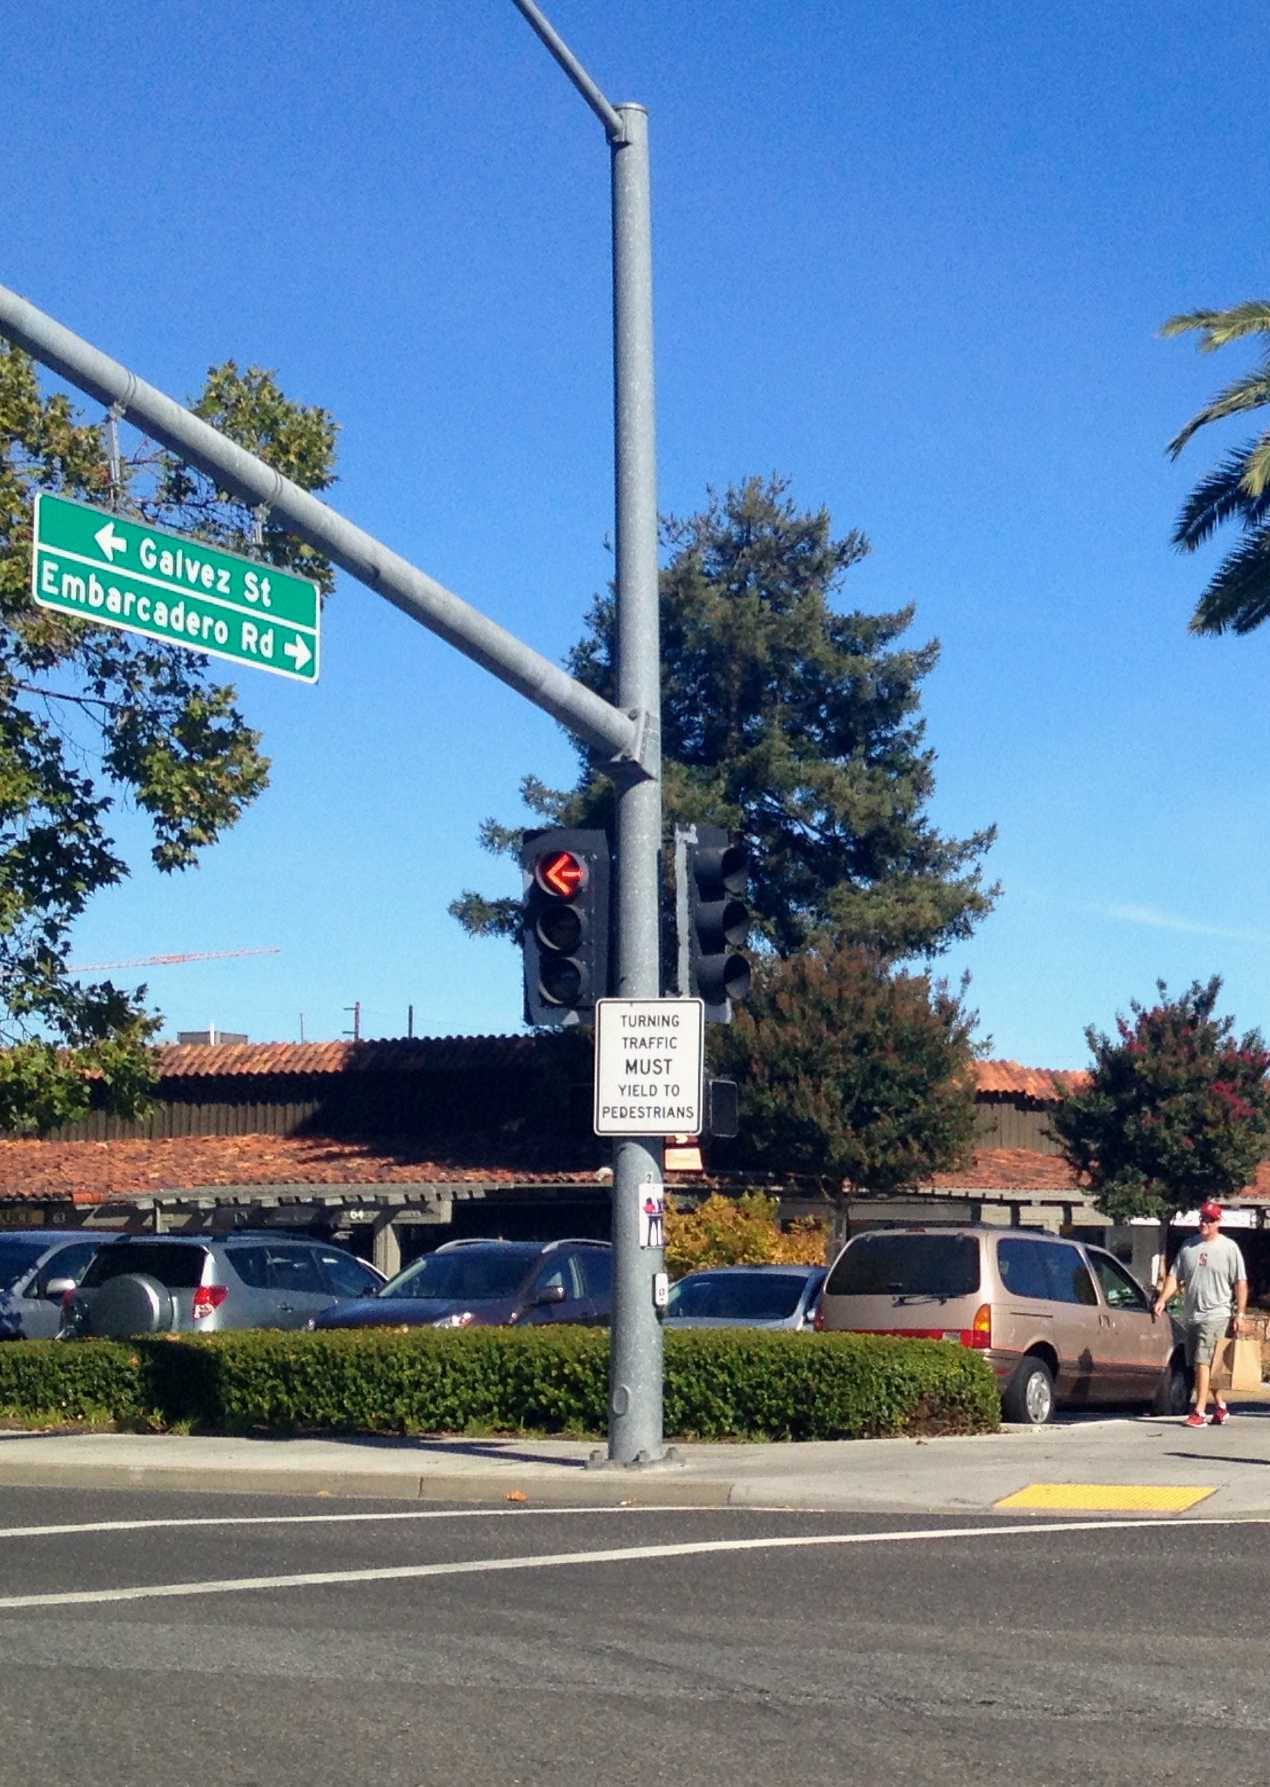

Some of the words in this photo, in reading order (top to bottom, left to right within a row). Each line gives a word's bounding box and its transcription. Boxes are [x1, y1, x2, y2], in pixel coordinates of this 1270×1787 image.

[139, 538, 231, 594] Galvez
[243, 571, 272, 607] St
[41, 560, 229, 644] Embarcadero
[241, 621, 274, 658] Rd
[620, 1014, 680, 1028] TURNING
[622, 1036, 678, 1050] TRAFFIC
[625, 1058, 673, 1076] MUST
[618, 1084, 658, 1097] YIELD
[663, 1084, 680, 1097] TO
[602, 1106, 695, 1119] PEDESTRIANS
